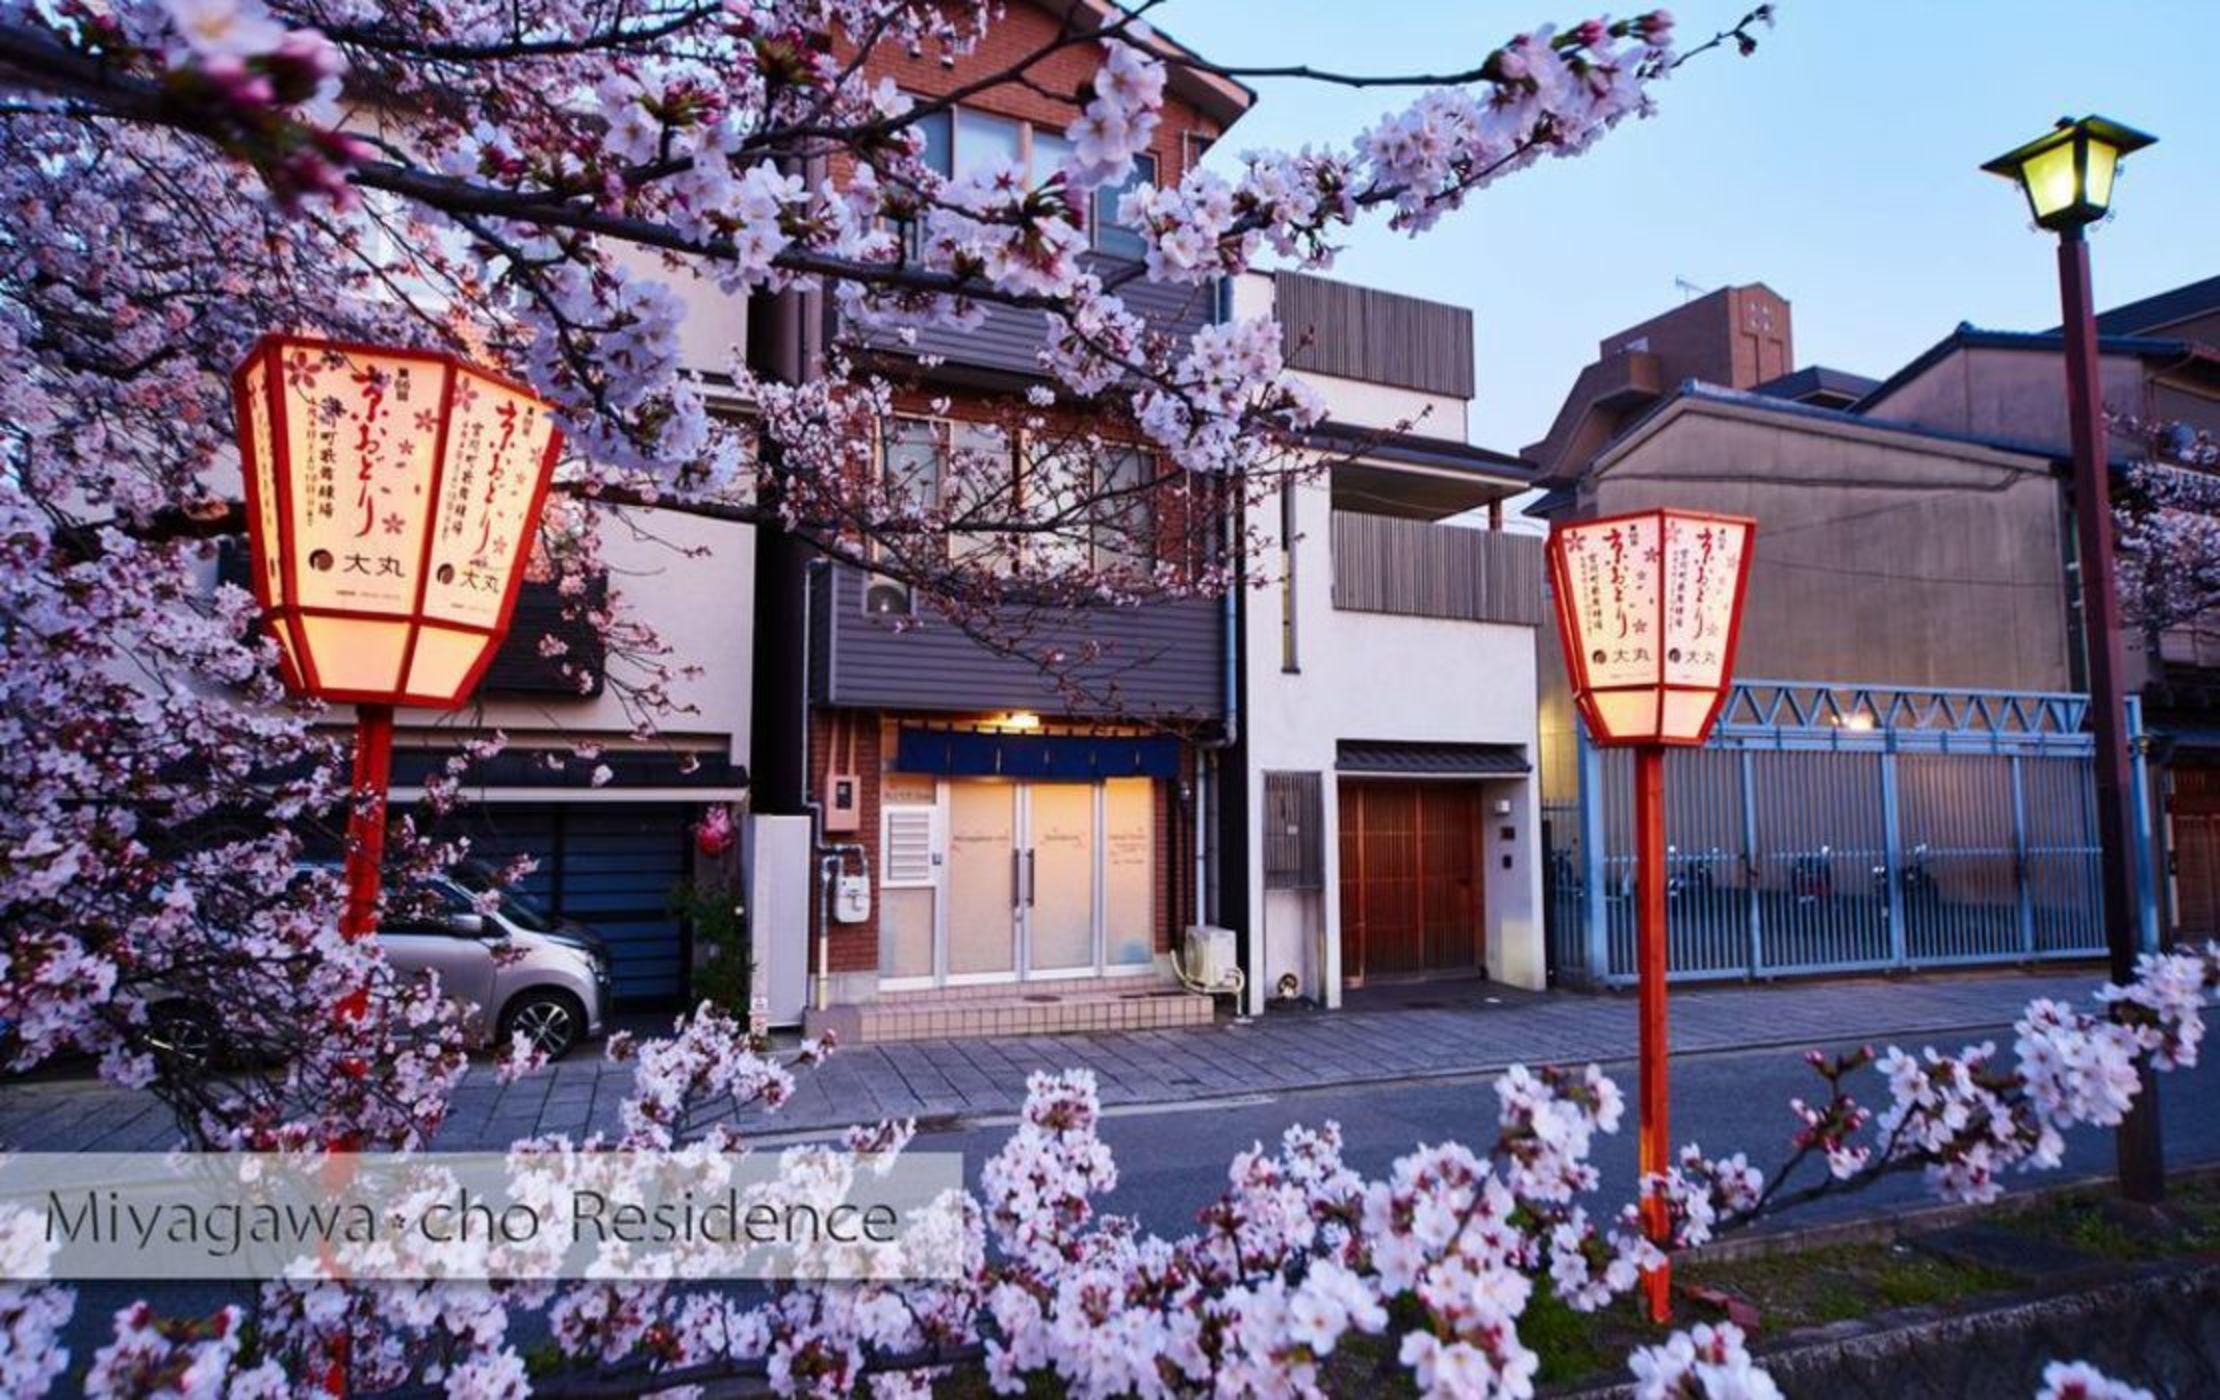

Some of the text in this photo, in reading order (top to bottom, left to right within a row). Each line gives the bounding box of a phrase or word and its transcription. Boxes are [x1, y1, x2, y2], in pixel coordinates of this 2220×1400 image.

[350, 364, 389, 538] 京おどり
[473, 400, 517, 555] 京おどり
[343, 552, 405, 578] 大丸
[460, 567, 500, 595] 大丸
[1602, 527, 1629, 639] 京おどり
[1693, 526, 1715, 640] 京おどり
[1613, 647, 1650, 664] 大丸
[1685, 649, 1717, 665] 大丸
